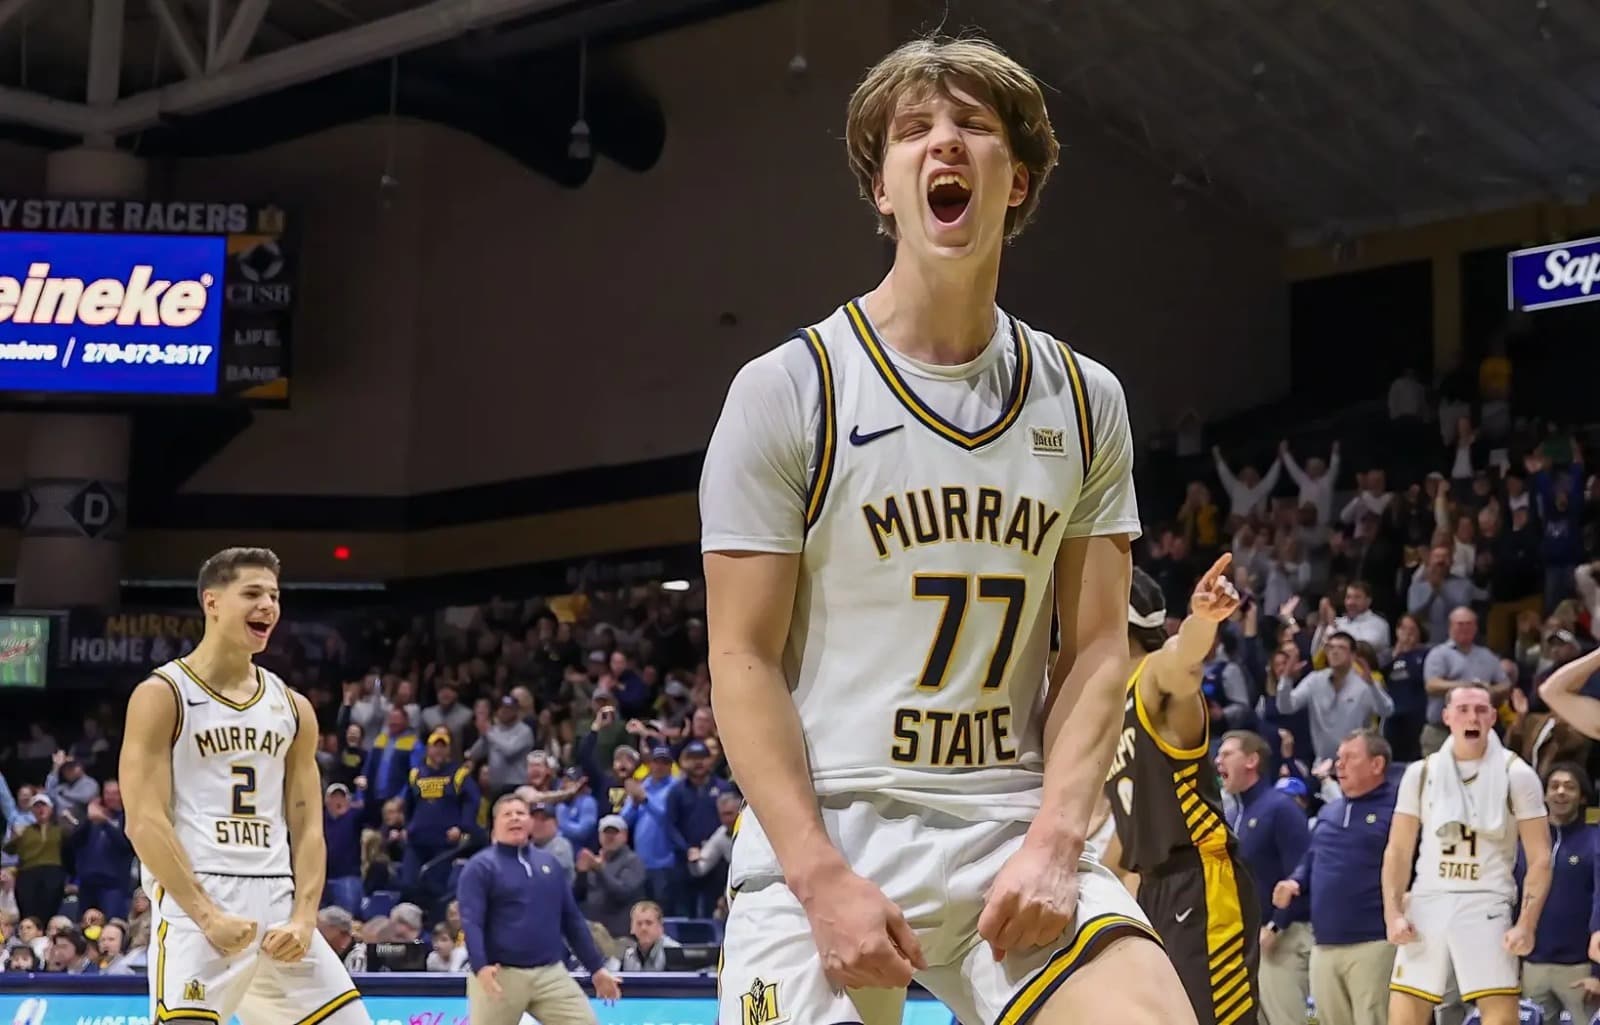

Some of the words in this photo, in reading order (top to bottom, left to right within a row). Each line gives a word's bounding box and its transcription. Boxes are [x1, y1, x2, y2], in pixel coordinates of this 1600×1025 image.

[22, 200, 115, 230] STATE
[123, 201, 248, 232] RACERS
[83, 493, 109, 526] D
[861, 486, 1061, 561] MURRAY
[911, 571, 1027, 693] 77
[71, 636, 145, 662] HOME
[194, 726, 286, 758] MURRAY
[891, 707, 1018, 766] STATE
[230, 763, 257, 816] 2
[216, 820, 271, 849] STATE
[1438, 861, 1481, 881] STATE
